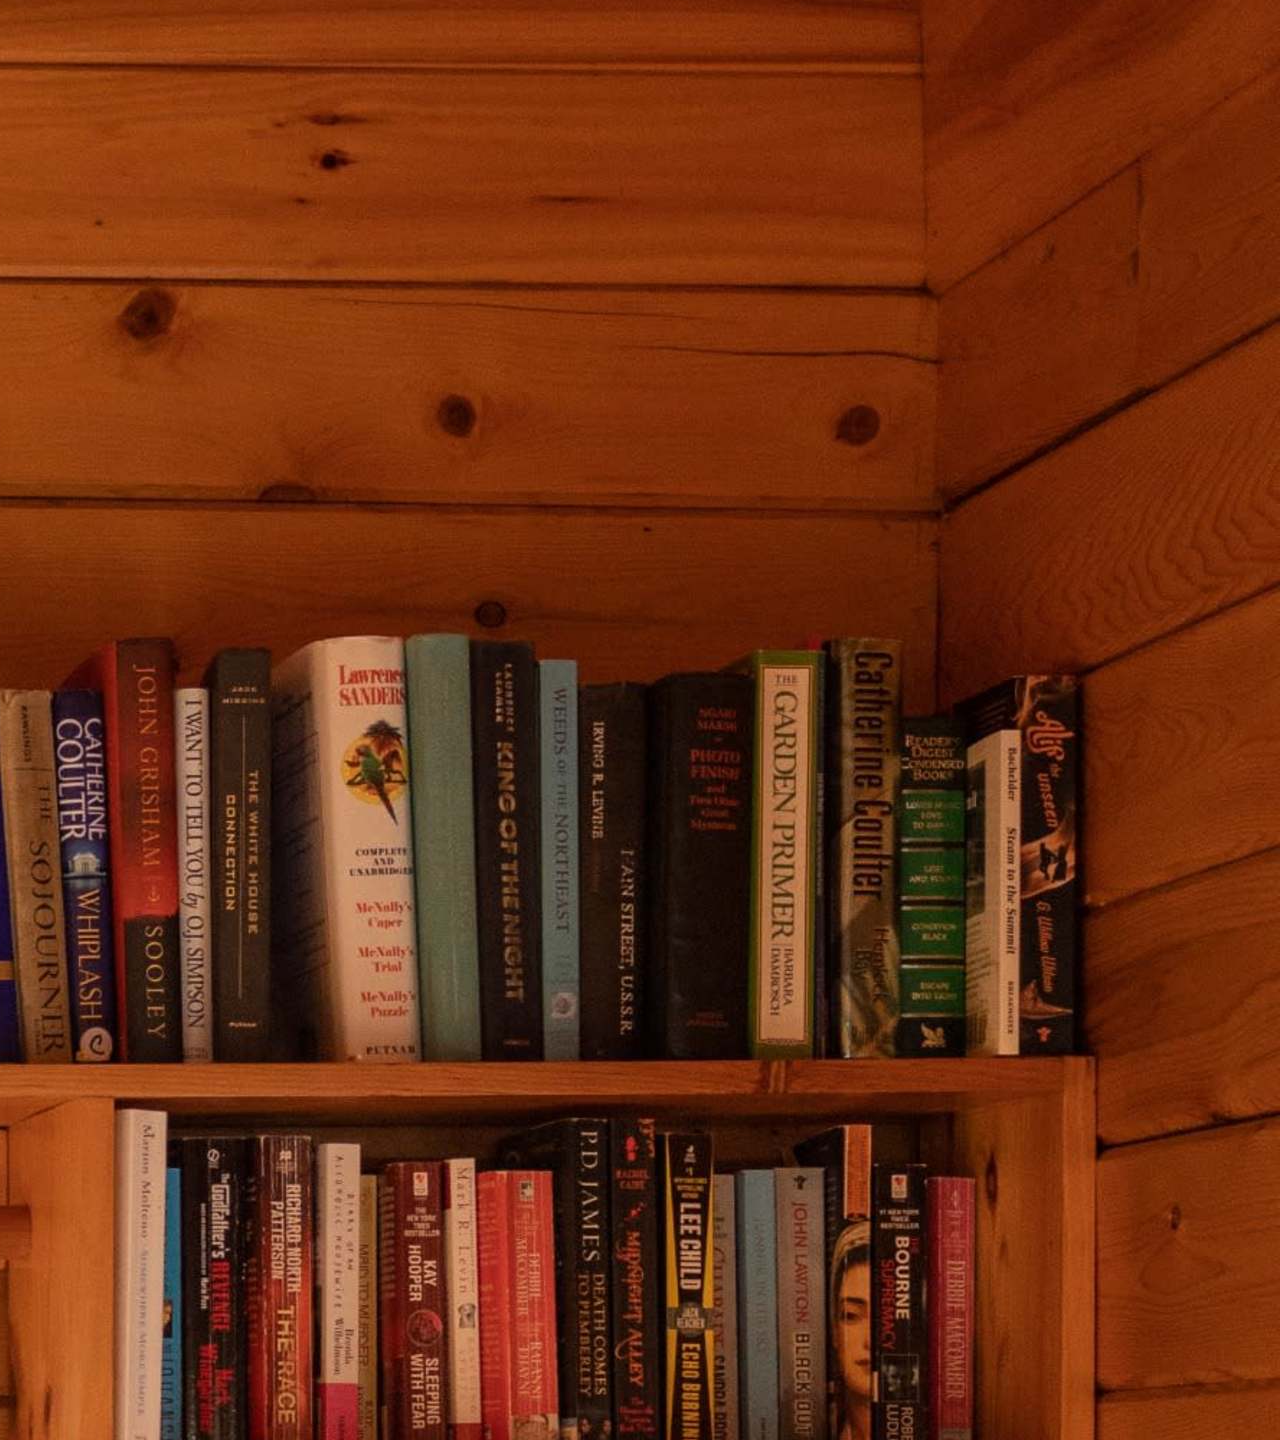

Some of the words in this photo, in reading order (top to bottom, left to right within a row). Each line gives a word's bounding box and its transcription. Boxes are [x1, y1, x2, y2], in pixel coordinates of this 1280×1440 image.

[57, 719, 86, 840] COULTER
[772, 690, 799, 810] GARDEN
[853, 649, 894, 793] Catherine
[771, 822, 796, 942] PRIMER
[852, 800, 893, 900] Coulter
[74, 889, 102, 1020] WHIPLASH
[145, 925, 166, 1040] SOOLEY
[679, 1202, 701, 1235] LEE
[679, 1239, 702, 1291] CHILD
[895, 1235, 910, 1321] BOURNE
